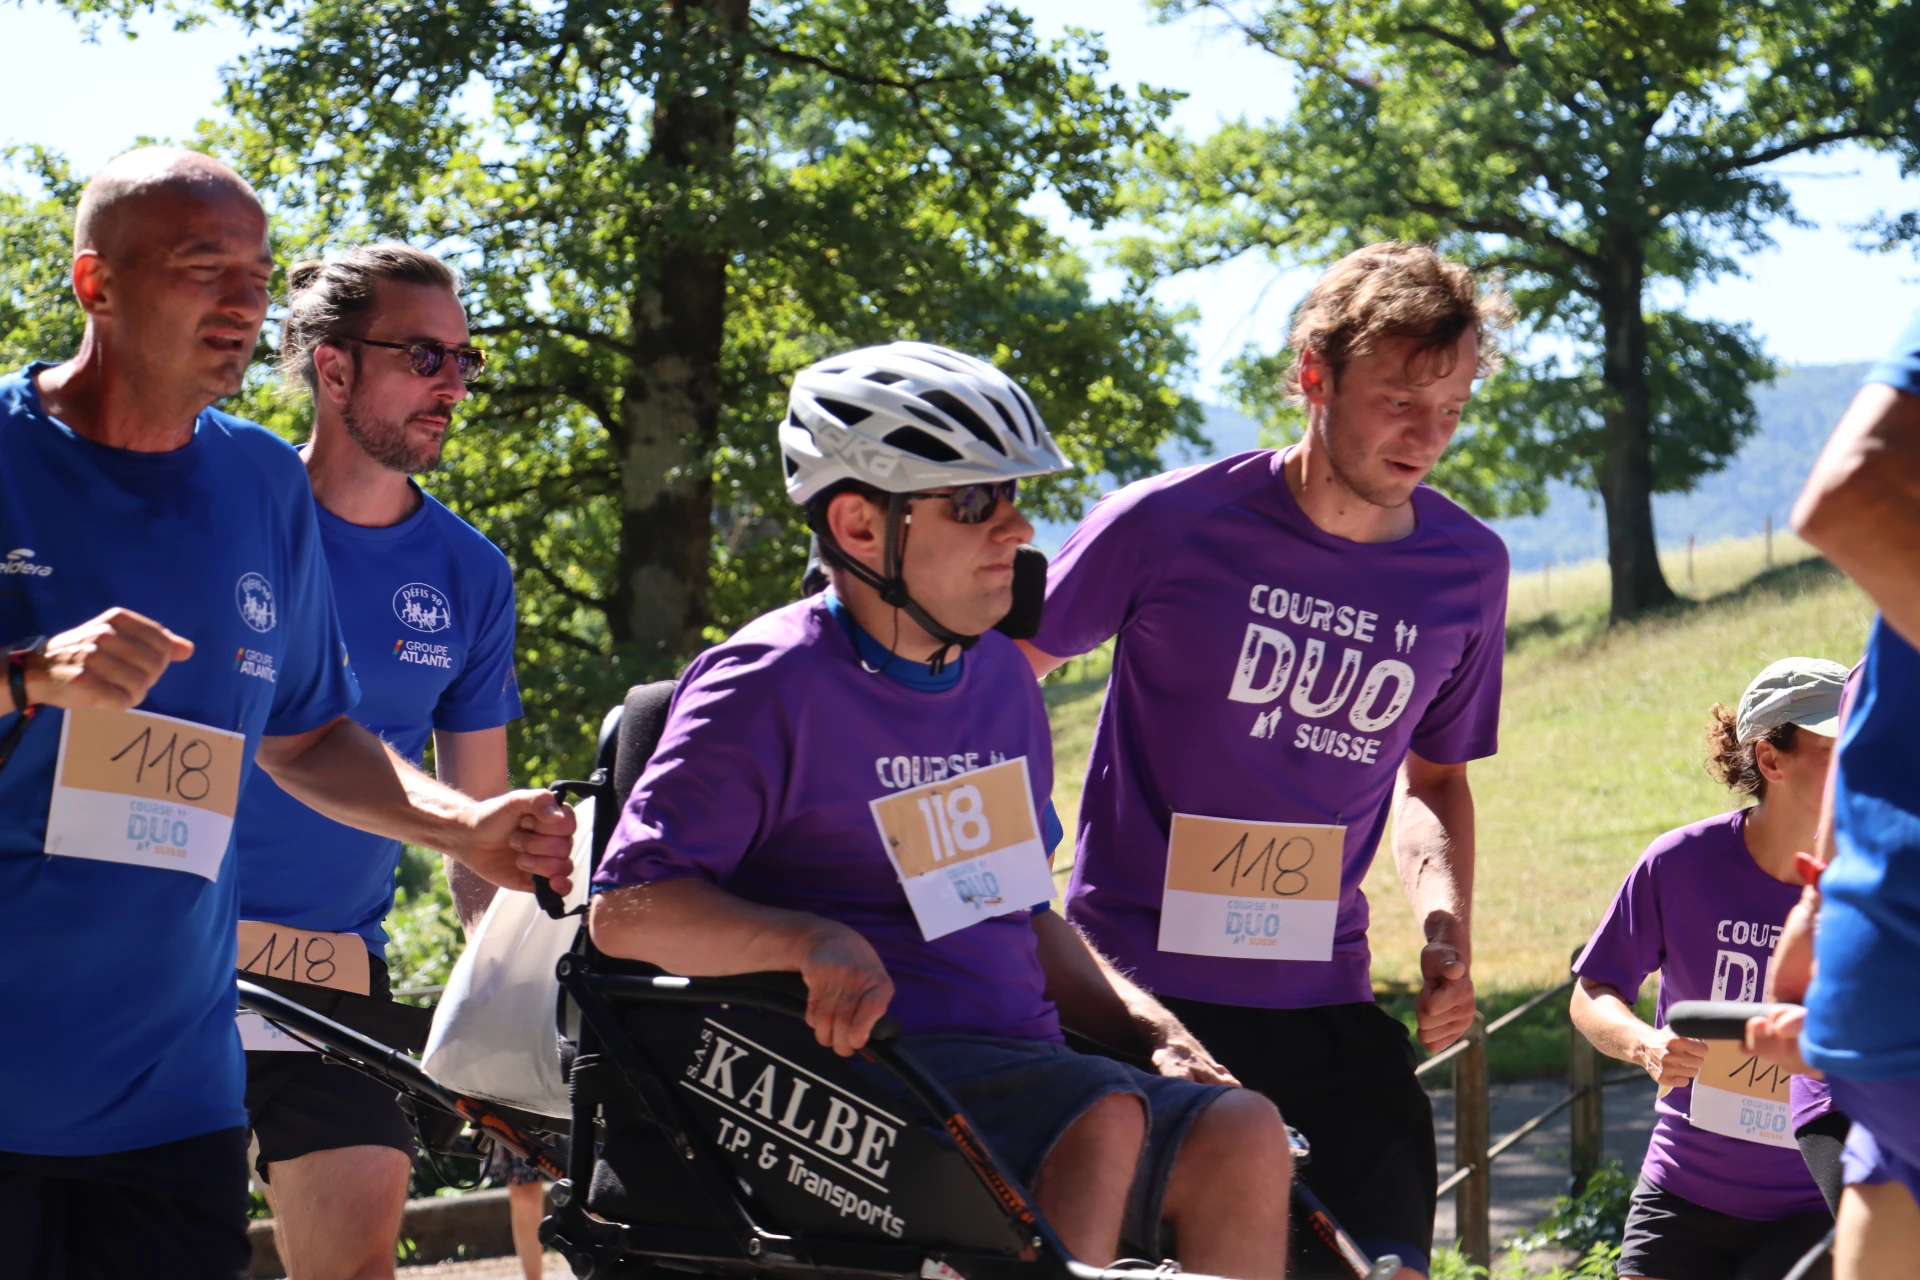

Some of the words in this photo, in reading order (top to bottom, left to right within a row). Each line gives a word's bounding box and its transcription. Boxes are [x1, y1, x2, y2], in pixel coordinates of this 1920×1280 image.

[402, 586, 429, 600] DÉFIS
[431, 594, 443, 606] 90
[1249, 584, 1379, 643] COURSE
[399, 651, 452, 668] ATLANTIC
[406, 641, 448, 656] GROUPE
[1228, 622, 1415, 732] DUO
[111, 727, 212, 801] 118
[1293, 723, 1381, 764] SUISSE
[127, 814, 188, 847] DUO
[917, 784, 991, 862] 118
[1212, 832, 1315, 896] 118
[1225, 911, 1280, 937] DUO
[1717, 919, 1785, 948] COUR
[244, 933, 336, 983] 118
[1729, 1055, 1791, 1093] 11
[700, 1036, 897, 1179] KALBE
[1740, 1107, 1786, 1133] DUO
[716, 1117, 751, 1159] T.P.
[758, 1142, 778, 1170] &
[787, 1154, 905, 1239] Transports
